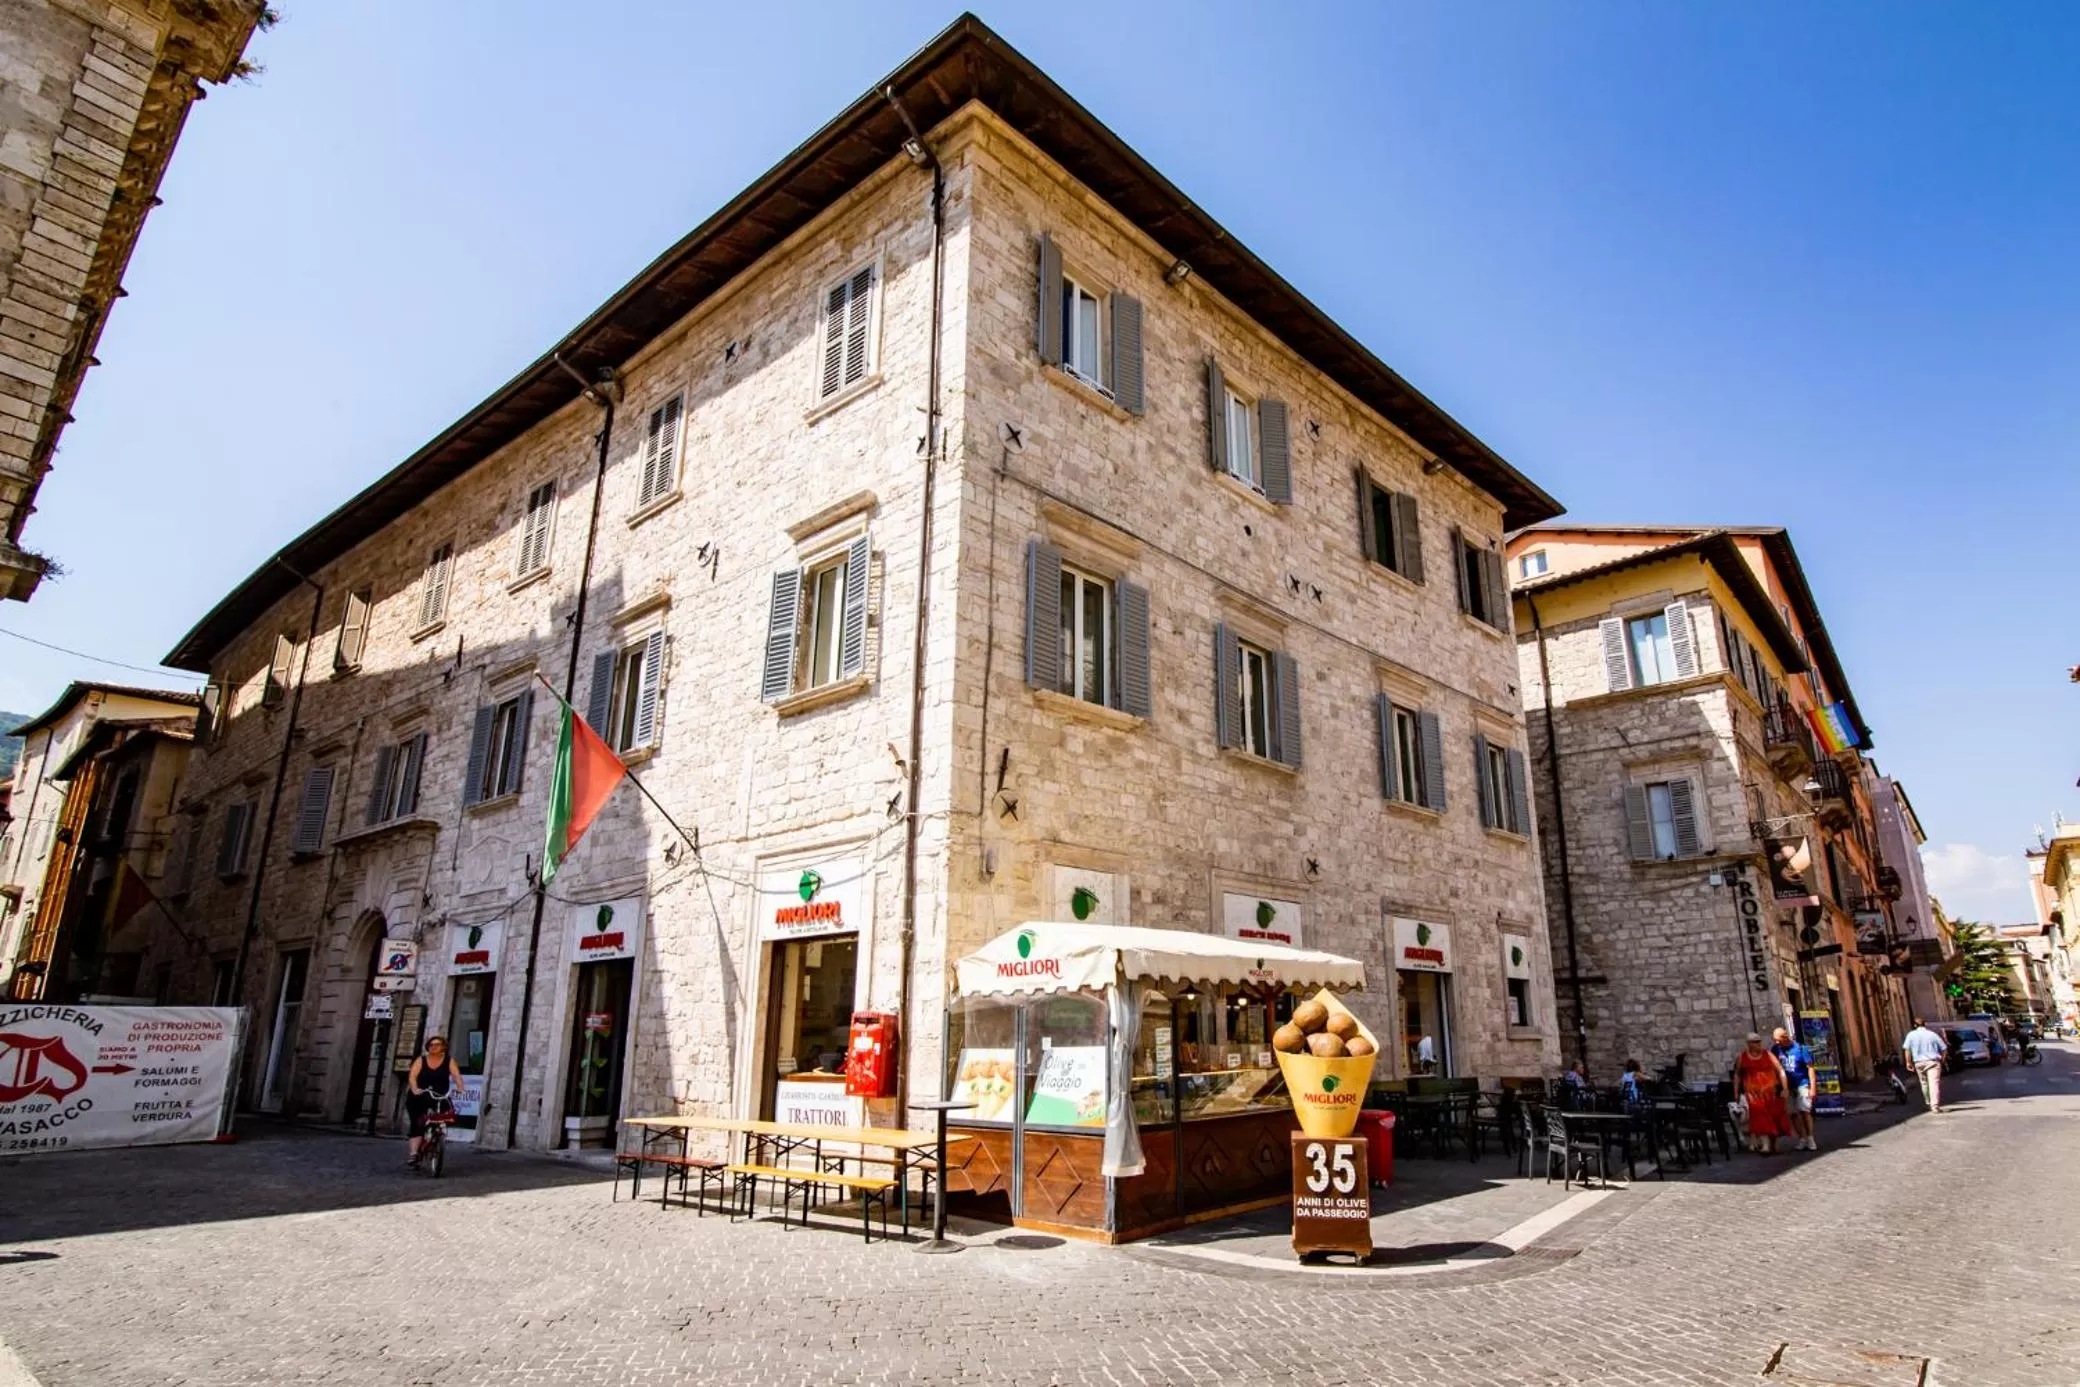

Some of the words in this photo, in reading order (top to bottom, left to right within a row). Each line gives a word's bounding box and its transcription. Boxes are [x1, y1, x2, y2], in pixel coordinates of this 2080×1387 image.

[997, 957, 1064, 980] MIGLIORI
[132, 1021, 222, 1031] GASTRONOMIA
[127, 1033, 141, 1042] DI
[144, 1031, 224, 1042] PRODUZIONE
[147, 1044, 202, 1053] PROPRIA
[141, 1066, 188, 1076] SALUMI
[191, 1066, 200, 1074] E
[134, 1078, 202, 1088] FORMAGGI
[1303, 1093, 1357, 1105] MIGLIORI
[21, 1103, 52, 1113] 1987
[134, 1101, 184, 1111] FRUTTA
[186, 1100, 194, 1108] E
[0, 1098, 93, 1135] ASACCO
[132, 1111, 193, 1122] VERDURA
[788, 1108, 849, 1126] TRATTORI
[1305, 1142, 1356, 1194] 35
[1297, 1196, 1321, 1207] ANNI
[1323, 1197, 1335, 1207] DI
[1336, 1197, 1367, 1208] OLIVE
[1297, 1207, 1311, 1217] DA
[1312, 1208, 1368, 1220] PASSEGGIO
